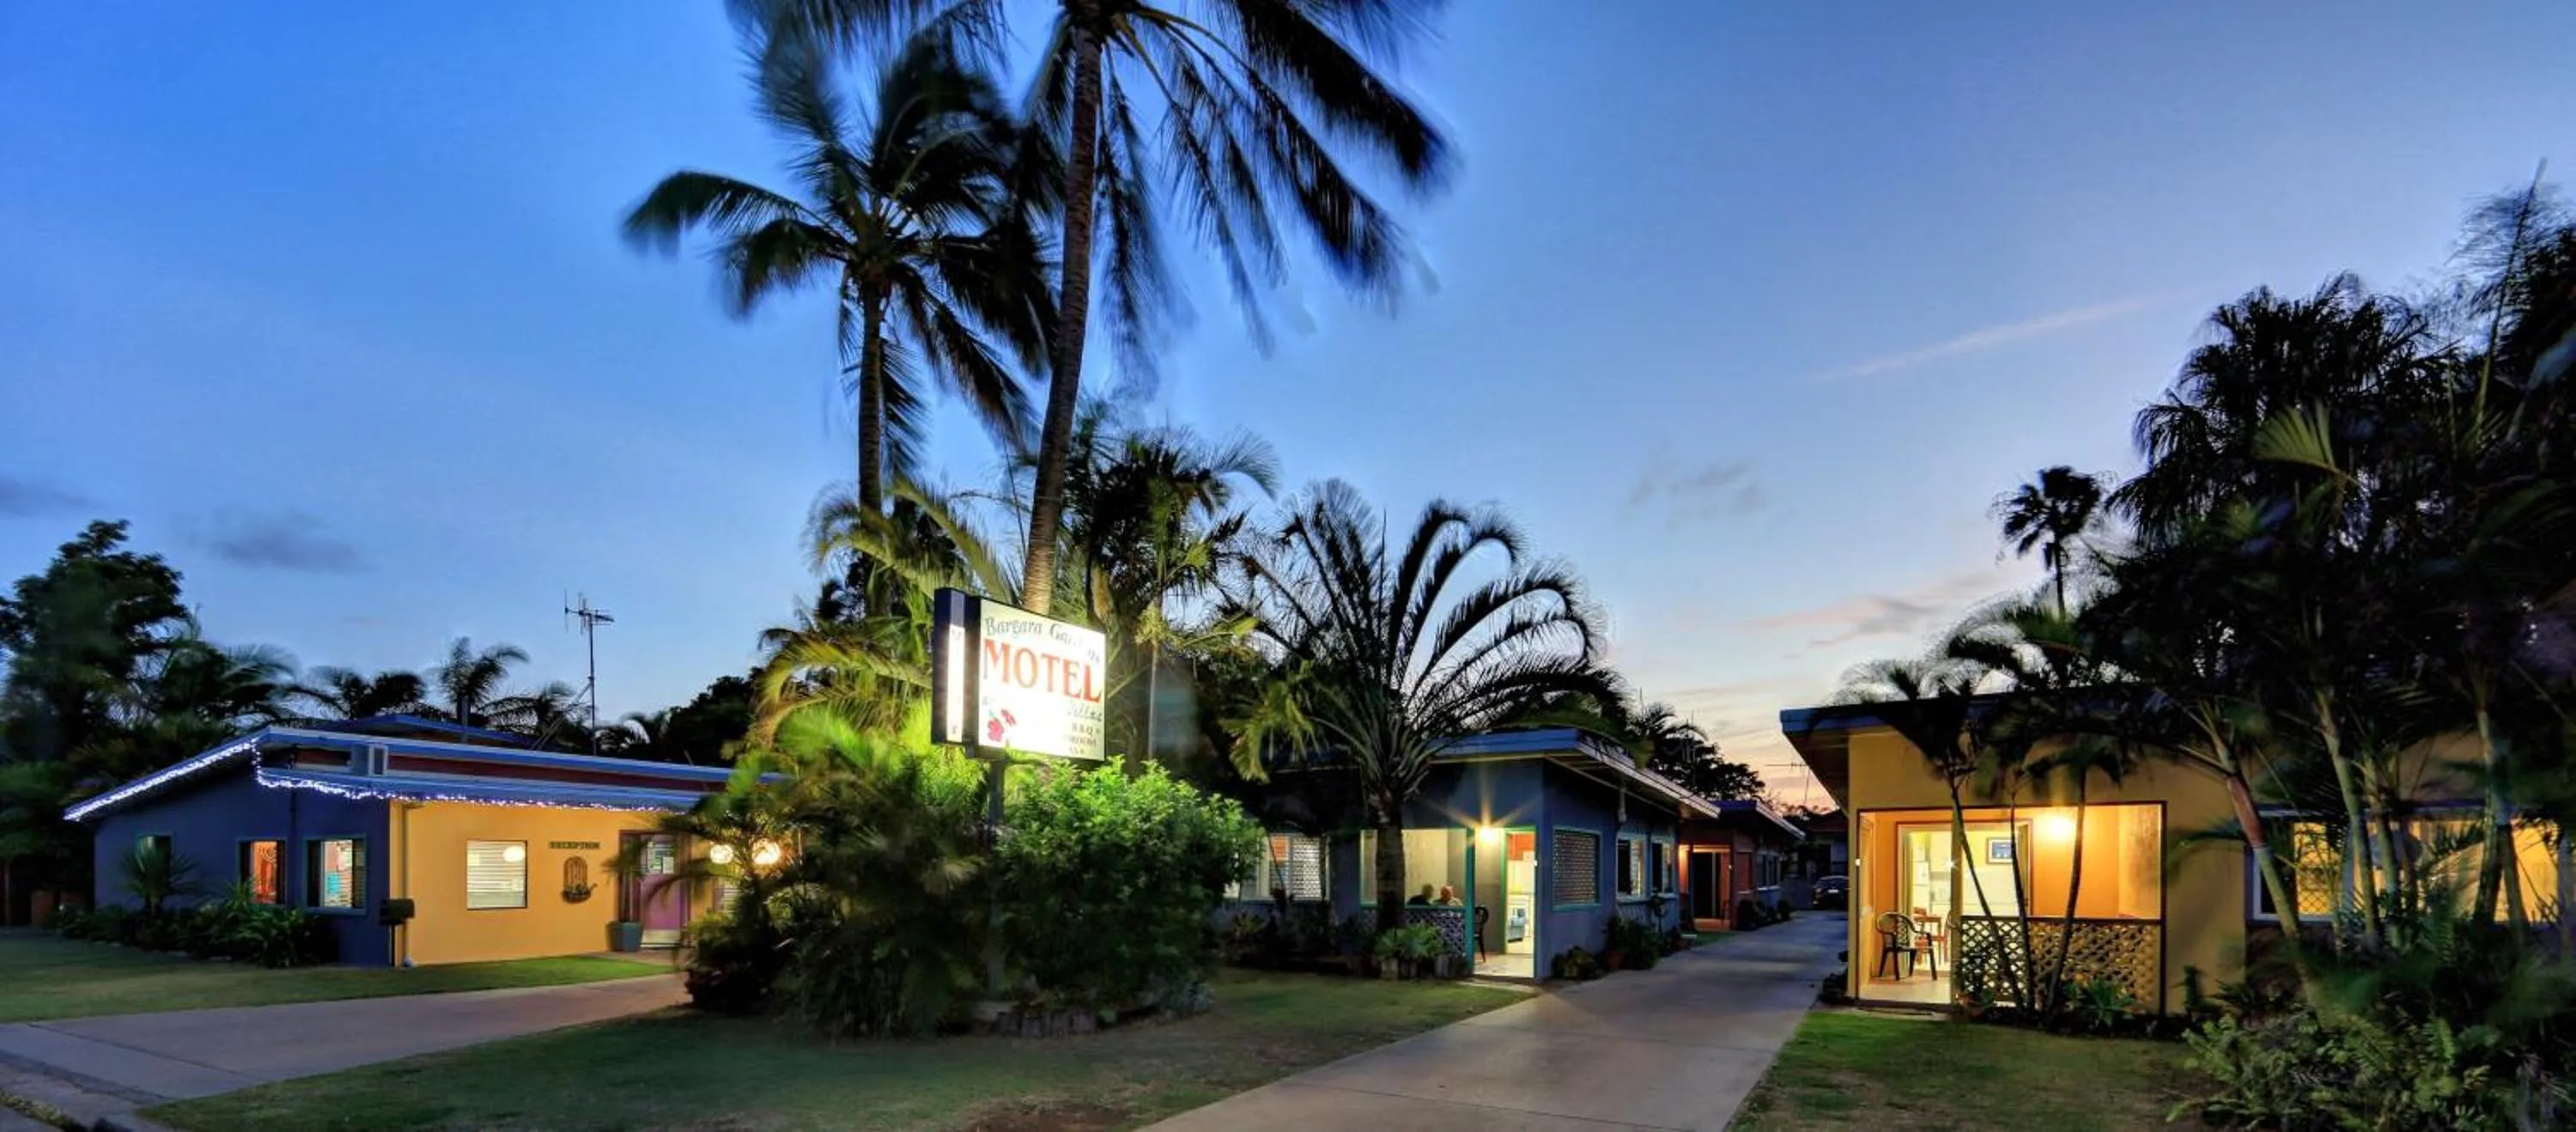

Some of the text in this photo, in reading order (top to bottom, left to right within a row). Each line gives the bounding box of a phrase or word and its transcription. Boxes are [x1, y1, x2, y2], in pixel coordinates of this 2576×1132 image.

[986, 617, 1100, 665] Bargara Gans
[983, 638, 1102, 703] MOTEL
